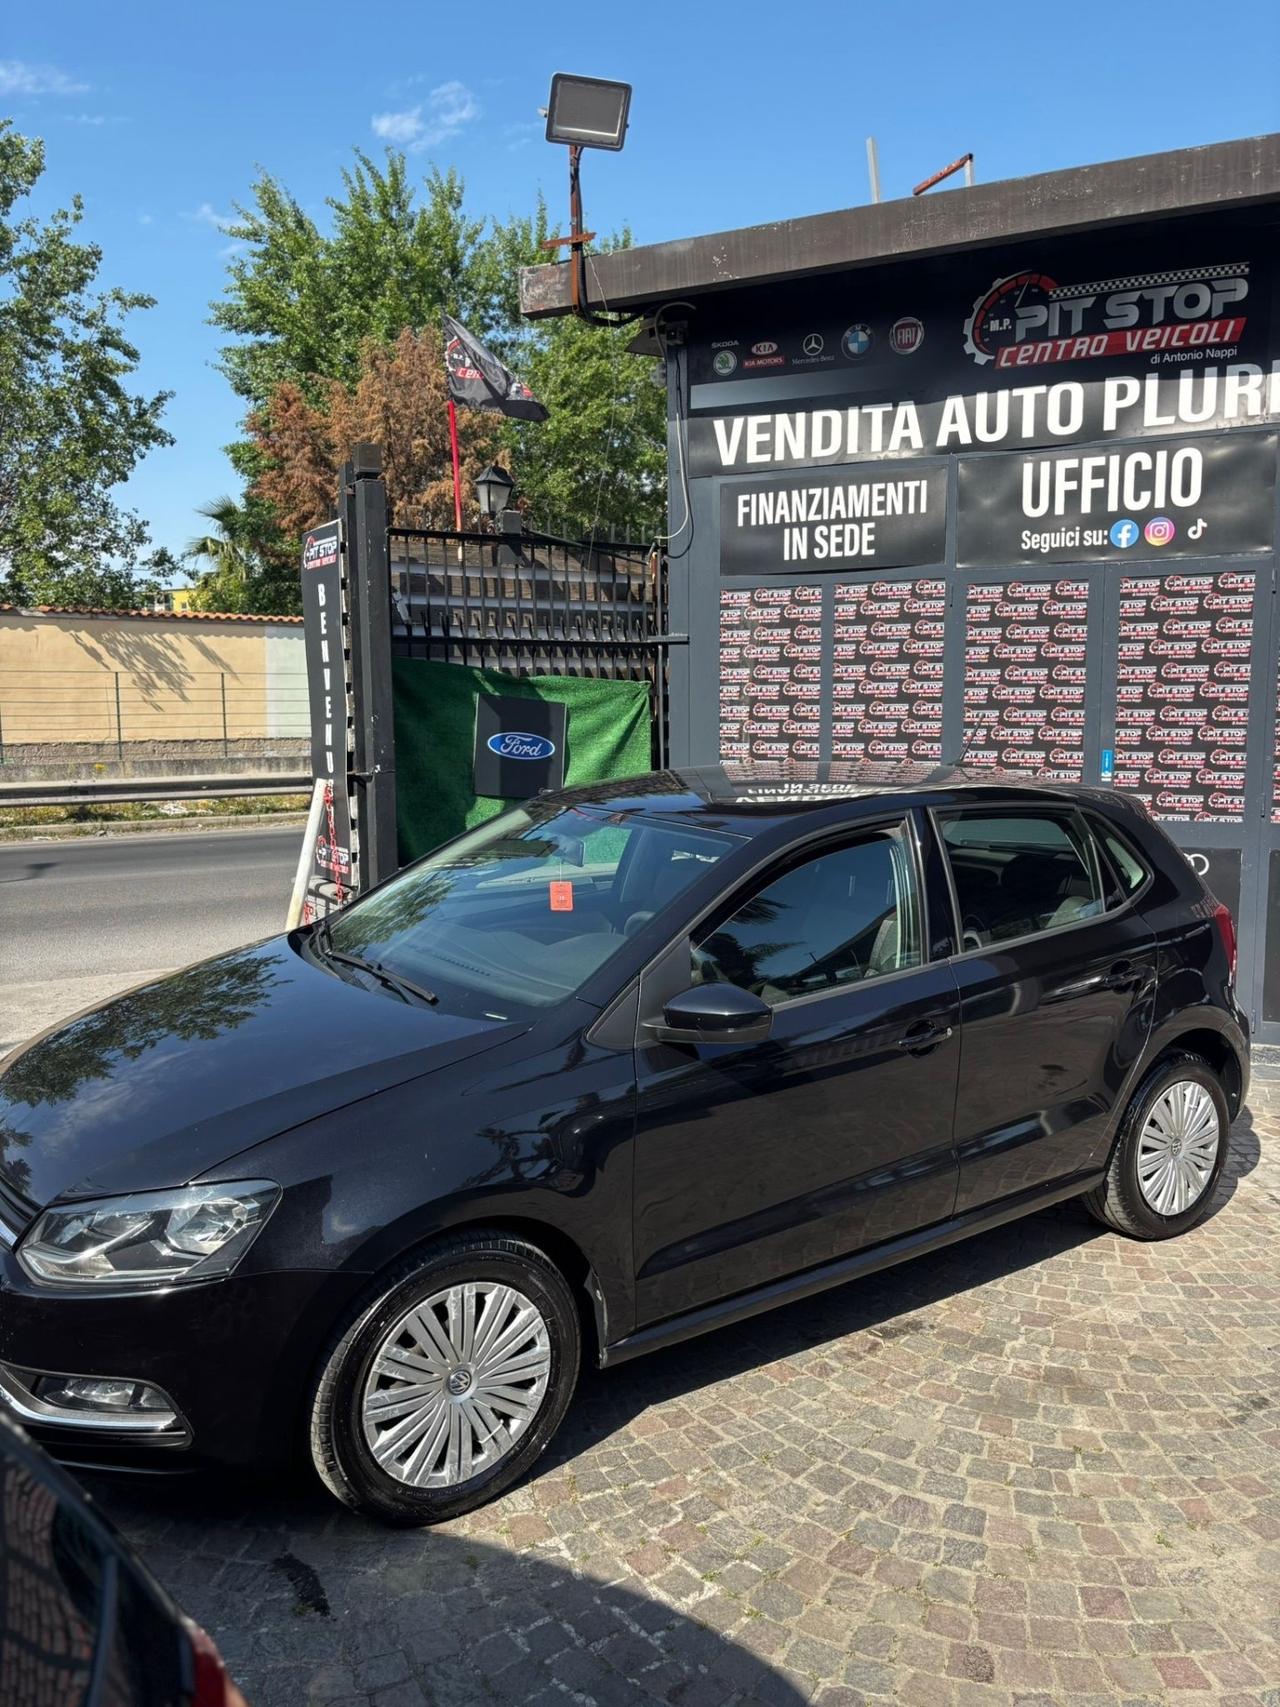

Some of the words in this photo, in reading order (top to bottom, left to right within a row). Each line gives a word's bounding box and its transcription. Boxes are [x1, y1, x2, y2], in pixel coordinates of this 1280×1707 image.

[1014, 296, 1097, 342] PIT
[1103, 278, 1249, 329] STOP
[755, 343, 774, 353] KIA
[1150, 353, 1161, 365] di
[1163, 349, 1203, 364] Antonio
[1205, 345, 1238, 362] Nappi
[713, 400, 925, 466] VENDITA
[935, 380, 1085, 447] AUTO
[1022, 447, 1203, 518] UFFICIO
[736, 479, 928, 527] FINANZIAMENTI
[783, 527, 810, 561] IN
[813, 521, 875, 559] SEDE
[1021, 526, 1080, 552] Seguici
[1083, 525, 1109, 549] su:
[500, 735, 542, 756] Ford
